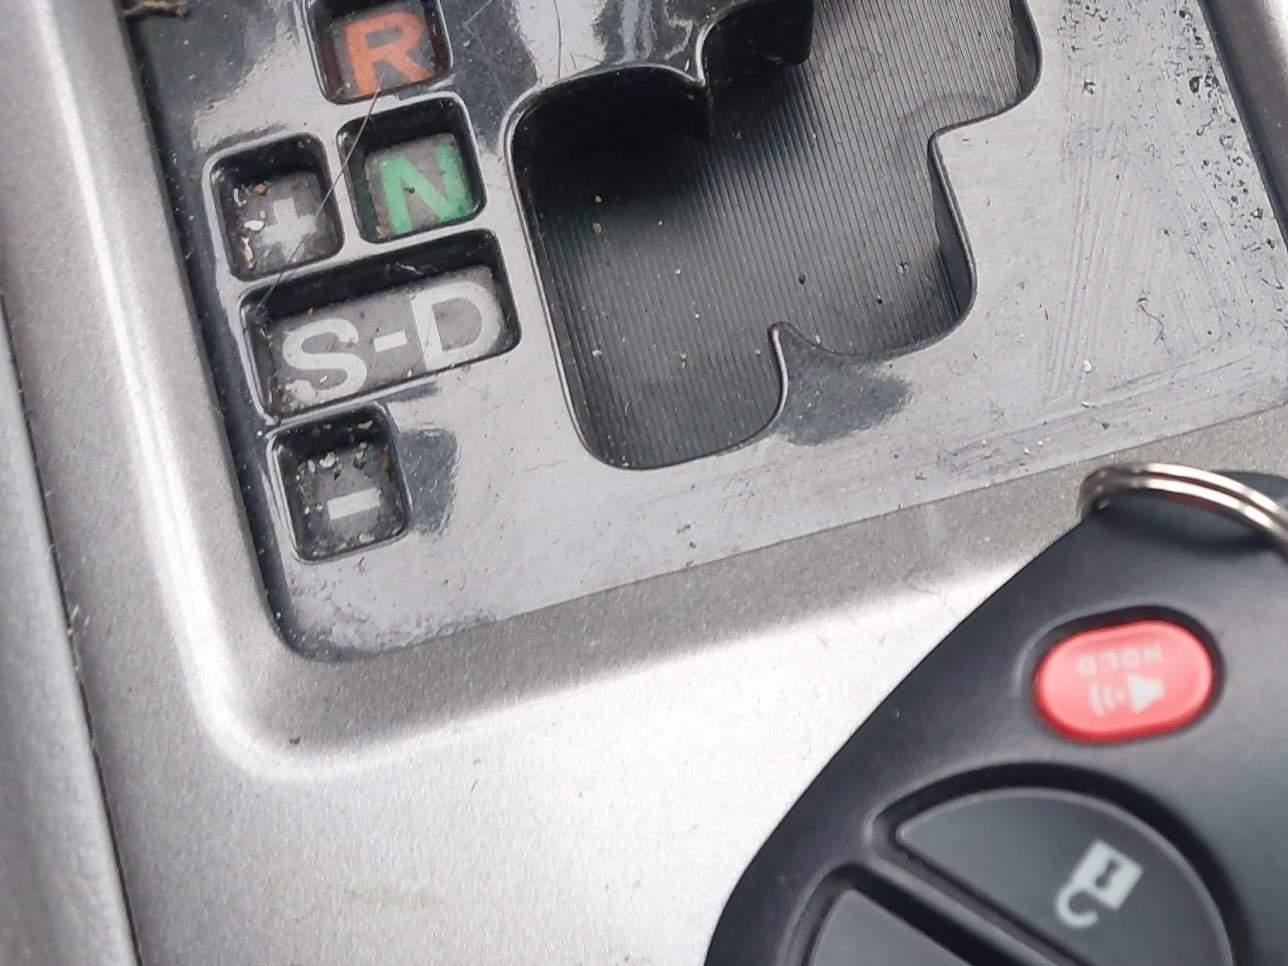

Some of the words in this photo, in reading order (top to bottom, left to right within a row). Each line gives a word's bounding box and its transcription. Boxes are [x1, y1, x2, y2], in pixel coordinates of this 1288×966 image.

[343, 12, 434, 98] R
[378, 143, 473, 236] N
[282, 281, 502, 398] S-D
